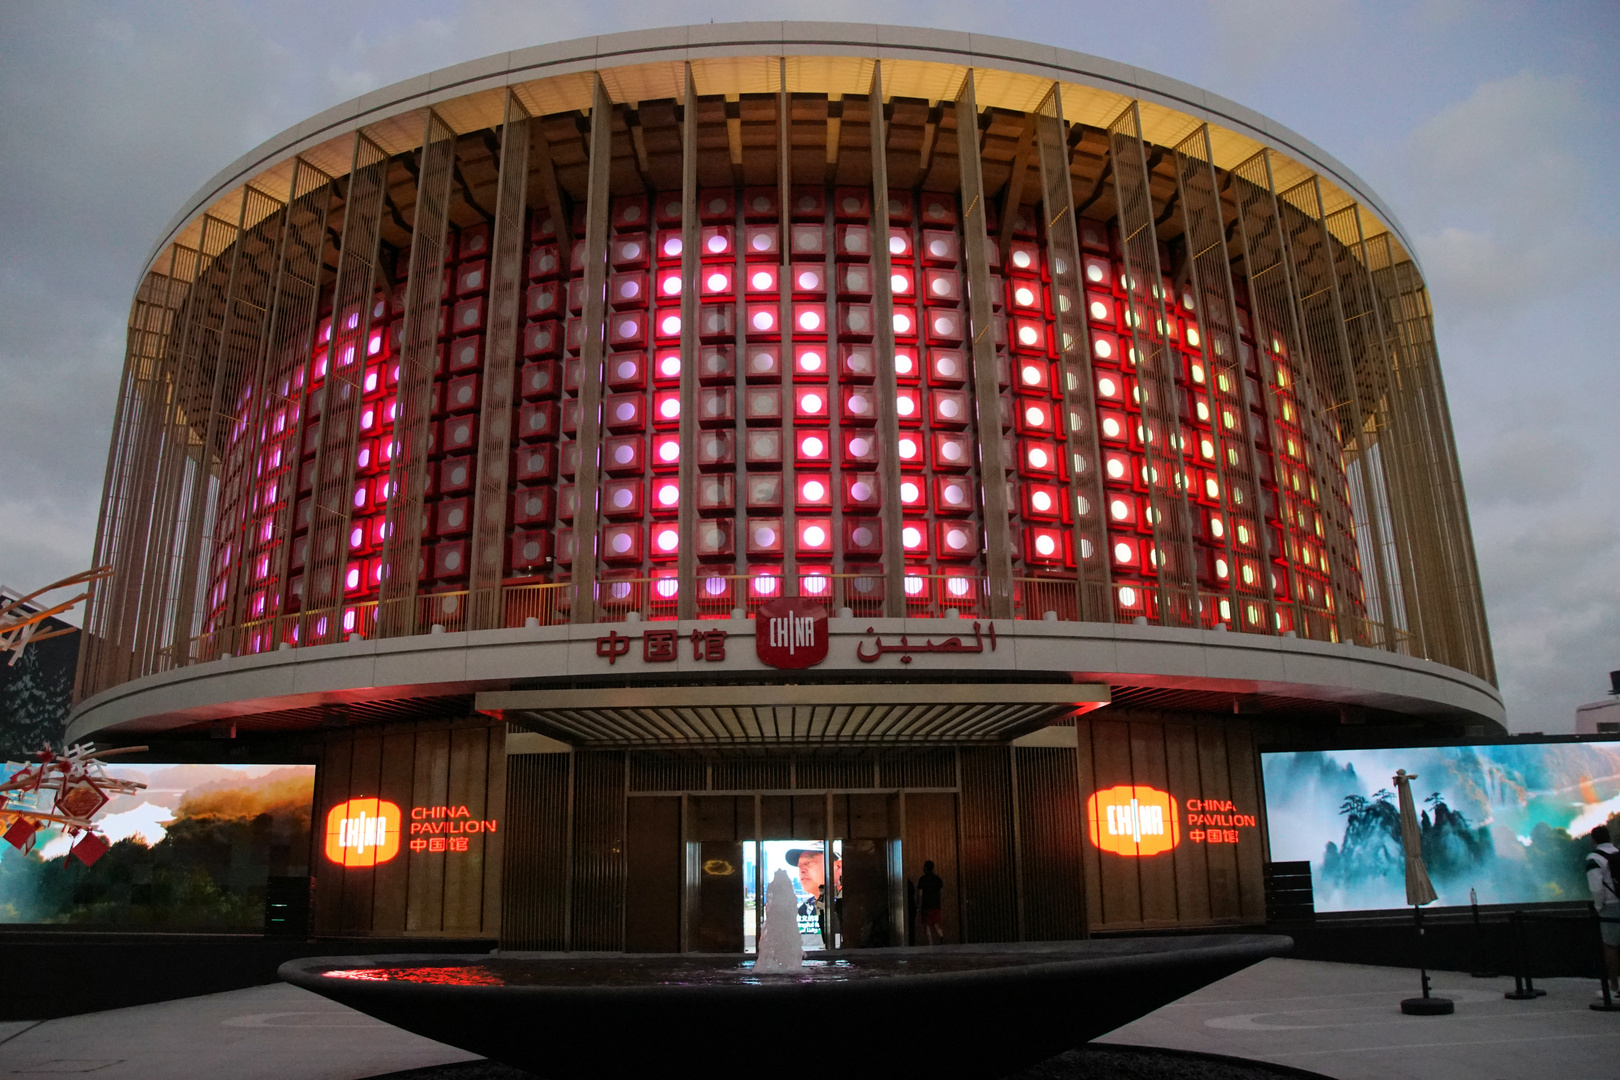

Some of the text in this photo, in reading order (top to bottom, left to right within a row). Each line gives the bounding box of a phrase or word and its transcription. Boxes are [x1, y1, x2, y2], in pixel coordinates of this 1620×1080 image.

[769, 610, 815, 655] CHINA
[596, 627, 727, 664] 中国馆
[857, 621, 997, 663] الصين
[411, 805, 470, 819] CHINA
[1186, 799, 1237, 812] CHINA
[410, 820, 497, 834] PAVILION
[1106, 798, 1164, 842] CHINA
[1187, 814, 1256, 827] PAVILION
[338, 810, 387, 854] CHINA
[1189, 829, 1239, 843] 中国馆
[410, 836, 469, 853] 中国馆
